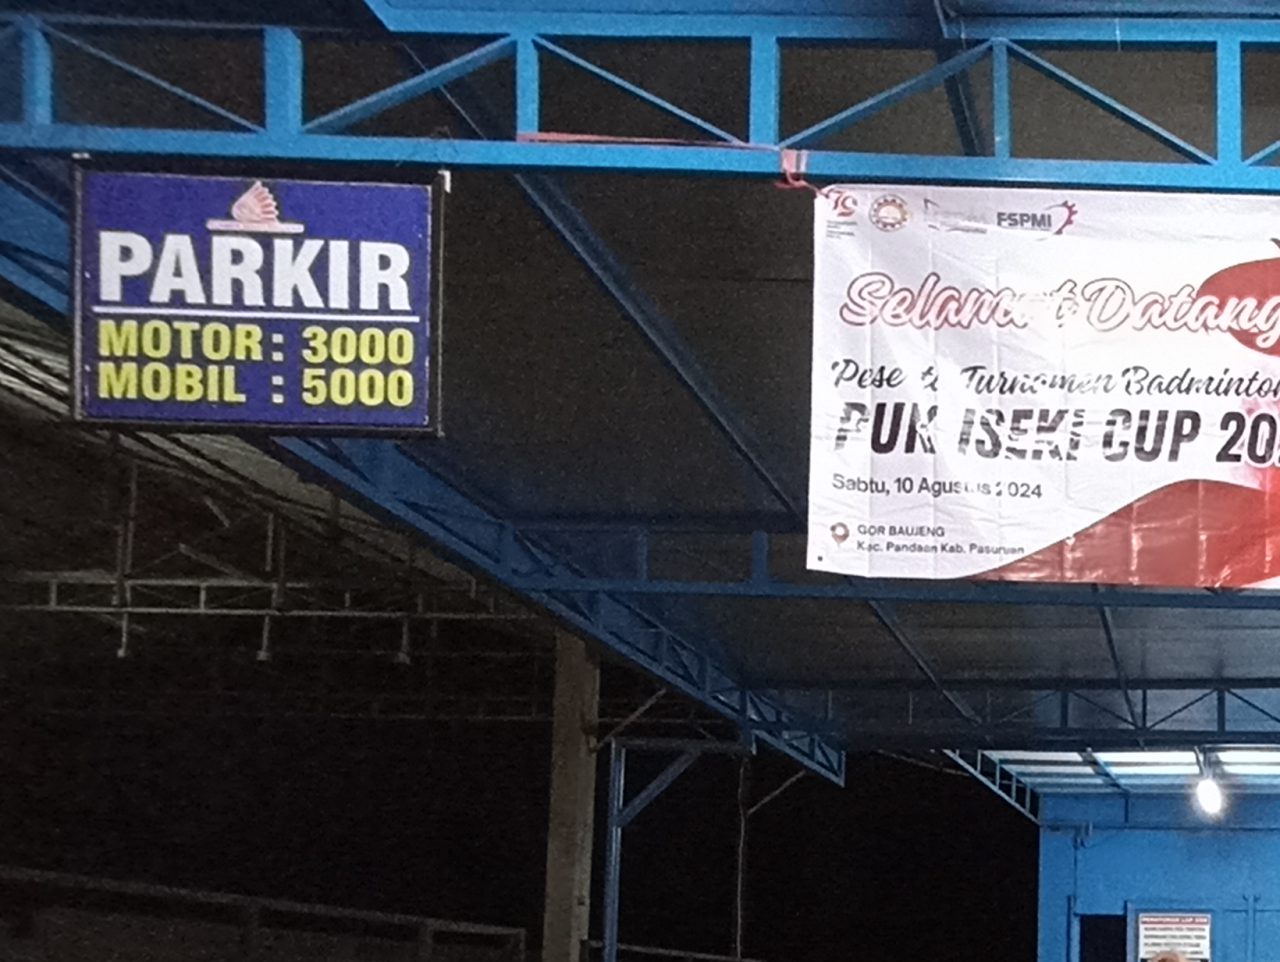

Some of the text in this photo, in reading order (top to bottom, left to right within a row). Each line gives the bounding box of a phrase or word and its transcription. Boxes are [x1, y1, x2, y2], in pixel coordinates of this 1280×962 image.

[996, 211, 1052, 229] FSPMI
[99, 230, 411, 310] PARKIR
[302, 326, 414, 364] 3000
[99, 362, 246, 403] MOBIL
[302, 368, 414, 407] 5000
[1102, 408, 1201, 463] CUP
[832, 473, 890, 495] Sabtu,
[894, 477, 914, 494] 10
[857, 524, 945, 538] GOR BAUJENG
